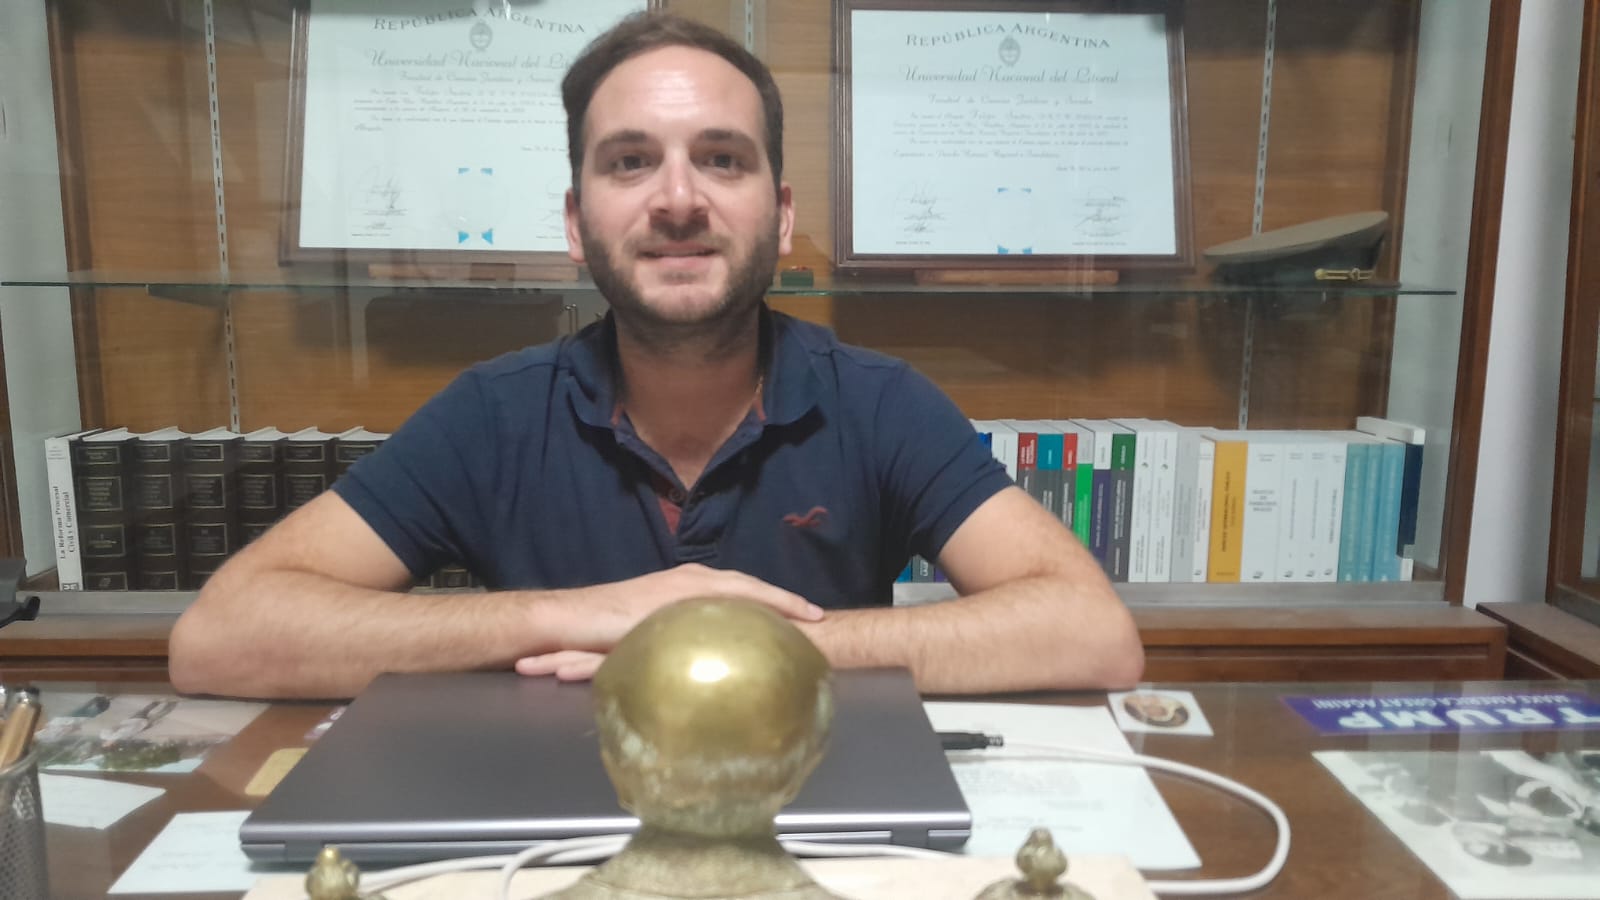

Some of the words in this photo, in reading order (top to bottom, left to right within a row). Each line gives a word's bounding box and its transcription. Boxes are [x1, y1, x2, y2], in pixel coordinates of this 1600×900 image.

[1013, 22, 1111, 49] ARGENTINA
[900, 65, 977, 82] Universidad
[980, 65, 1045, 83] Nacional
[1050, 69, 1068, 83] del
[52, 485, 63, 516] Procesal
[62, 491, 74, 529] Comercial
[56, 517, 66, 548] Reforma
[59, 549, 66, 559] La
[1378, 697, 1437, 708] GREAT
[1337, 707, 1600, 729] TRUMP
